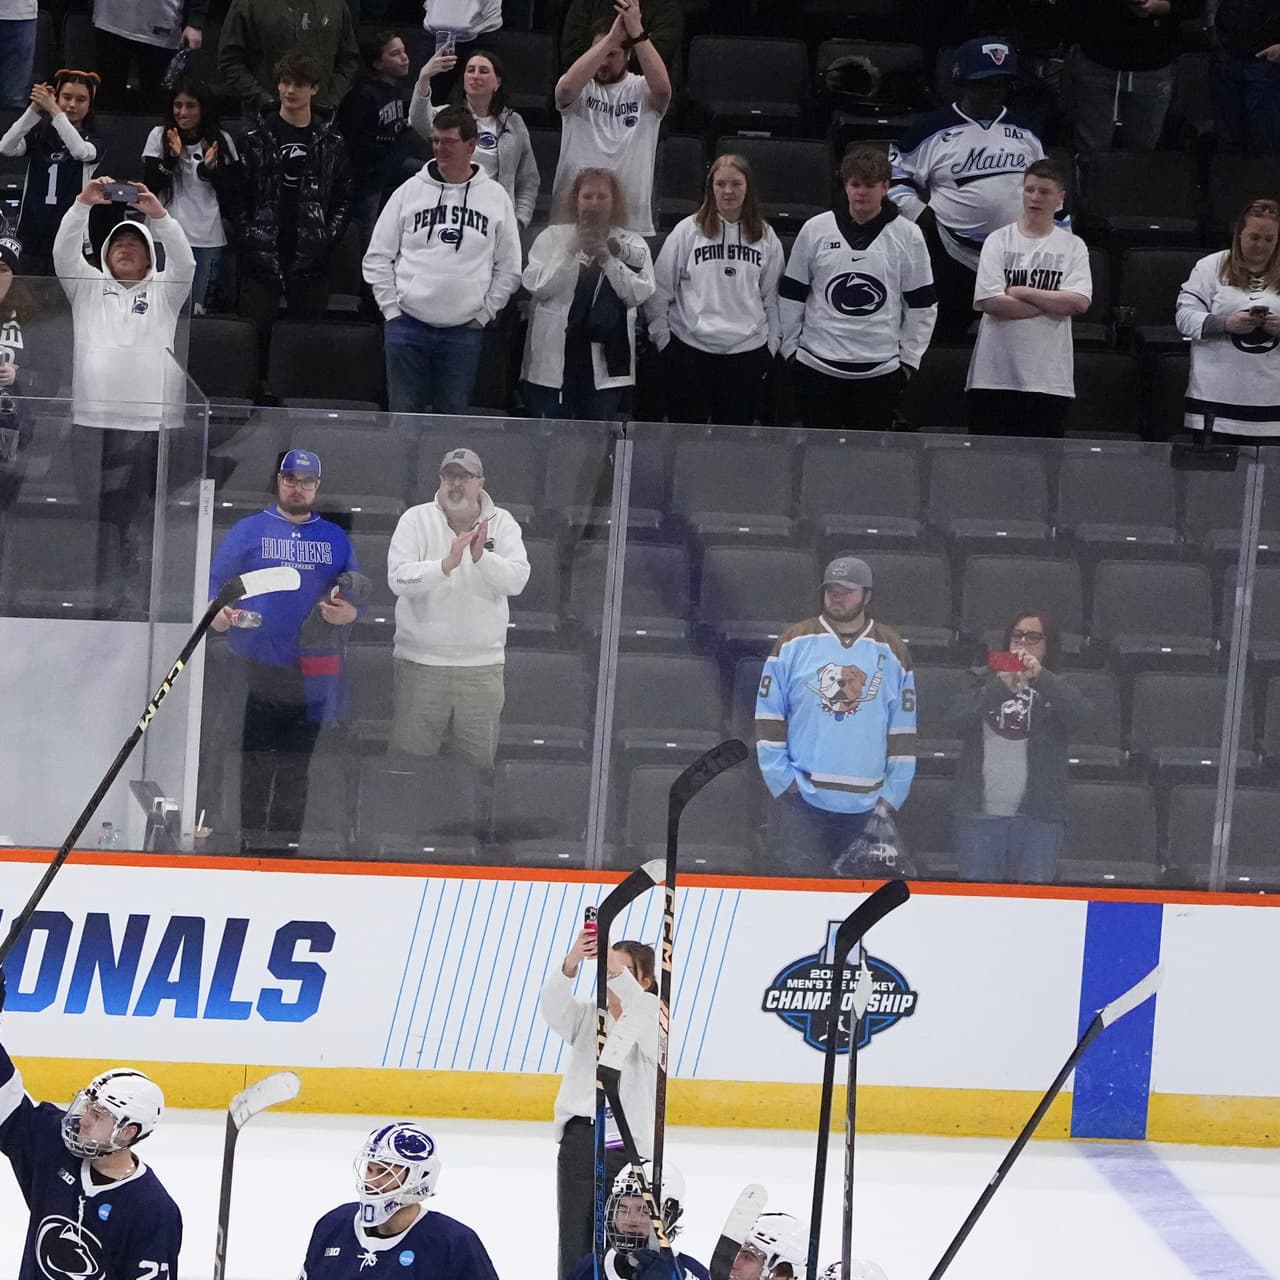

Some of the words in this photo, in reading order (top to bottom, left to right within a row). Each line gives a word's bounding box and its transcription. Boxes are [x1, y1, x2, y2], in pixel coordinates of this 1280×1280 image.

[951, 147, 1026, 174] Maine
[413, 205, 448, 234] PENN
[452, 205, 488, 237] STATE
[694, 244, 724, 265] PENN
[727, 244, 762, 267] STATE
[262, 537, 295, 560] BLUE
[297, 540, 333, 564] HENS
[140, 660, 184, 732] CCM
[787, 979, 824, 989] MEN'S
[825, 980, 847, 989] IE
[849, 981, 896, 991] HKEY
[810, 969, 851, 979] 205
[765, 990, 914, 1013] CHAMPOSHIP
[593, 1157, 606, 1252] JETSPEED
